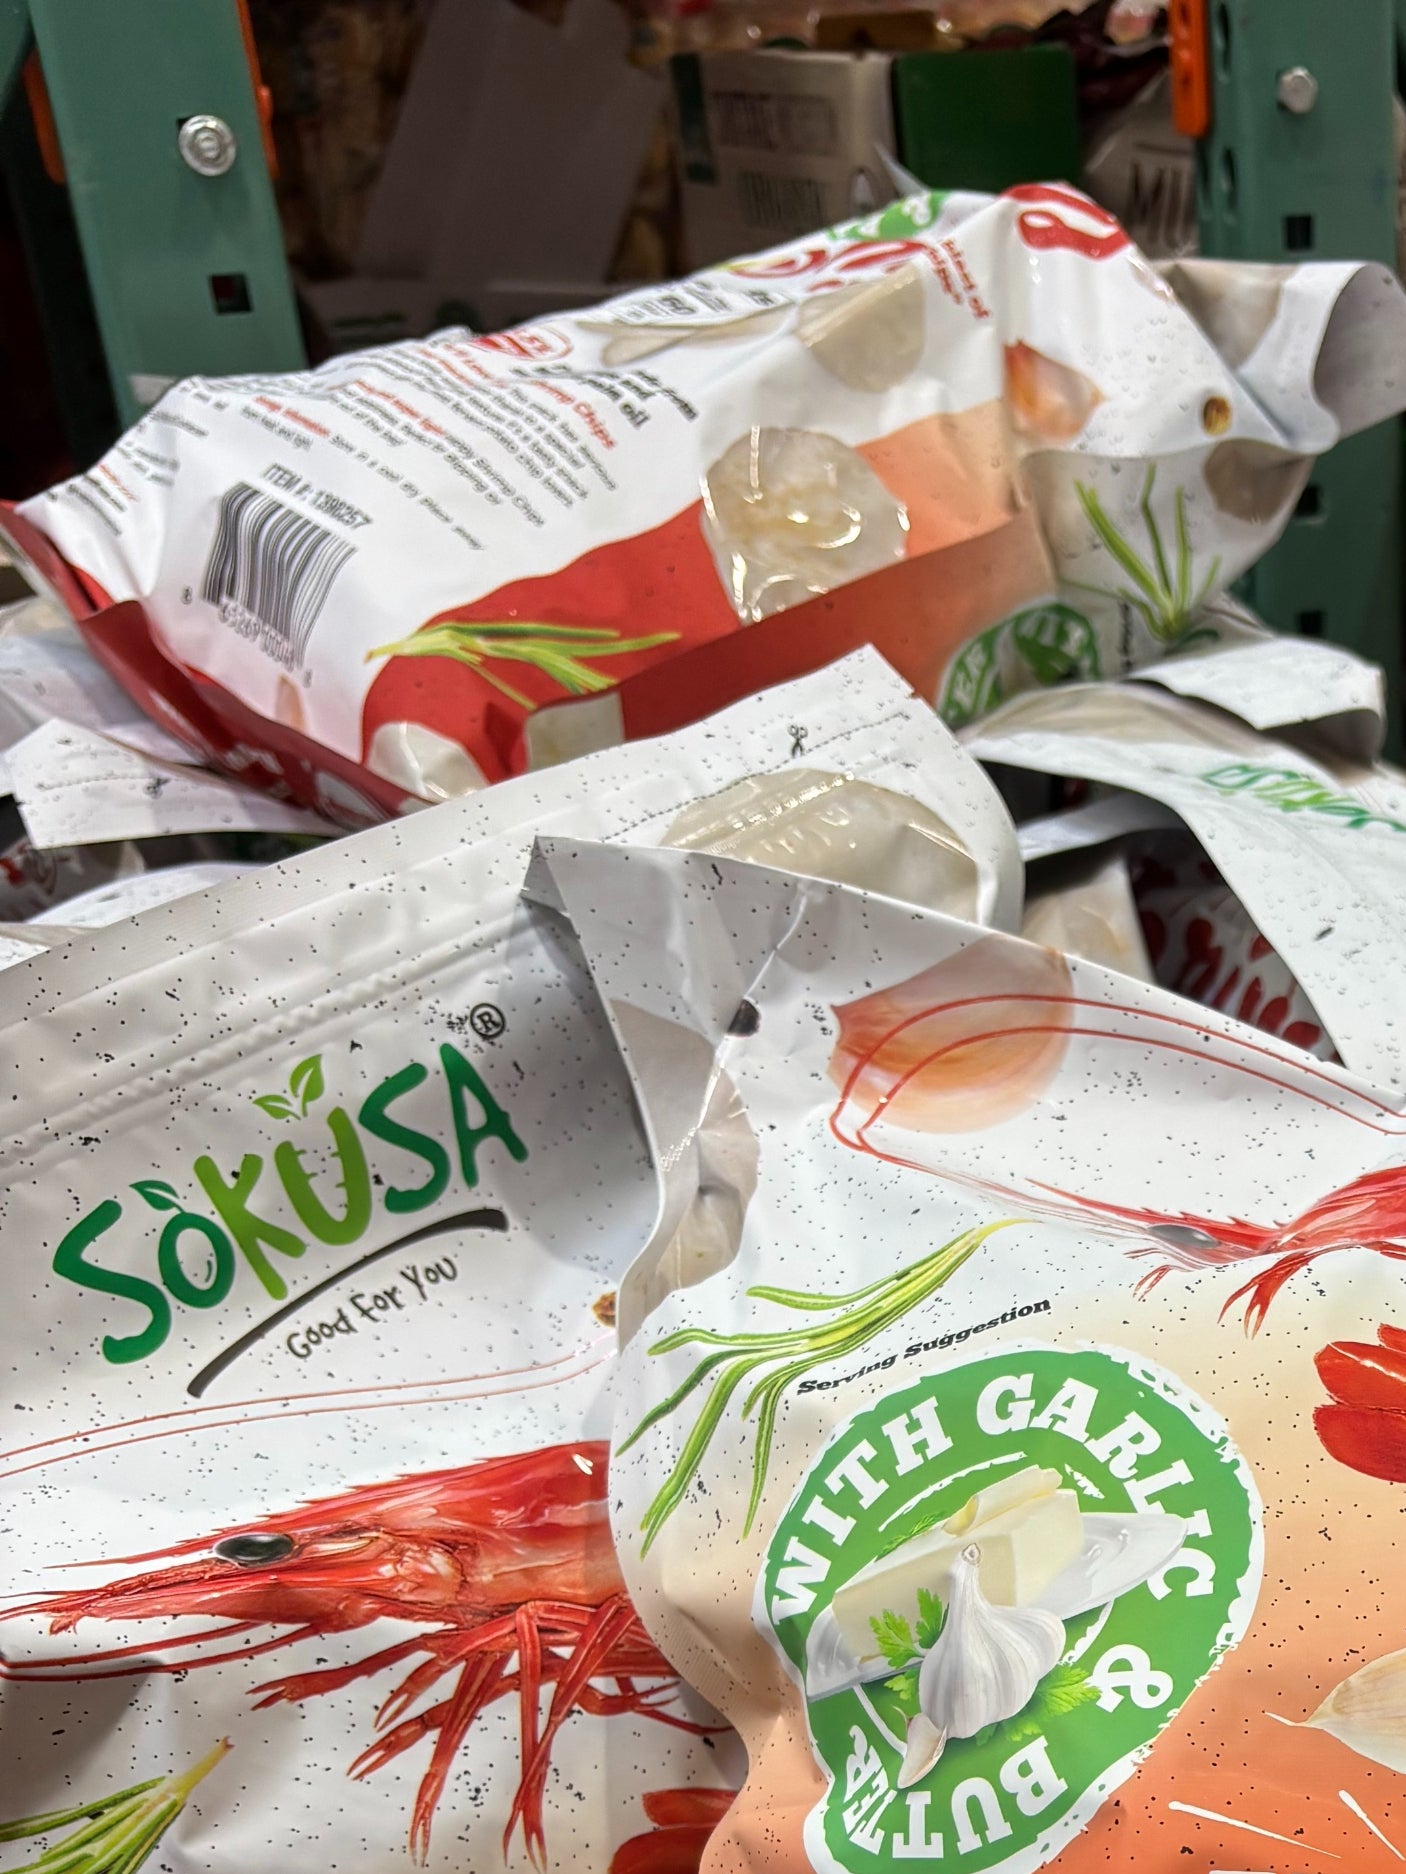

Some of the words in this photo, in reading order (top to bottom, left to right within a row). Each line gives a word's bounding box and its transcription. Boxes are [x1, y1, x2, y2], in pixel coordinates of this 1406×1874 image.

[260, 462, 302, 492] ITEM
[286, 1307, 357, 1360] Good
[356, 1284, 404, 1325] For
[399, 1256, 459, 1301] You
[796, 1352, 896, 1397] Serving
[903, 1297, 1052, 1360] Suggestion
[771, 1397, 954, 1625] WITH
[976, 1373, 1217, 1602] GARLIC
[1092, 1643, 1175, 1714] &
[842, 1724, 1069, 1859] BUTTER
